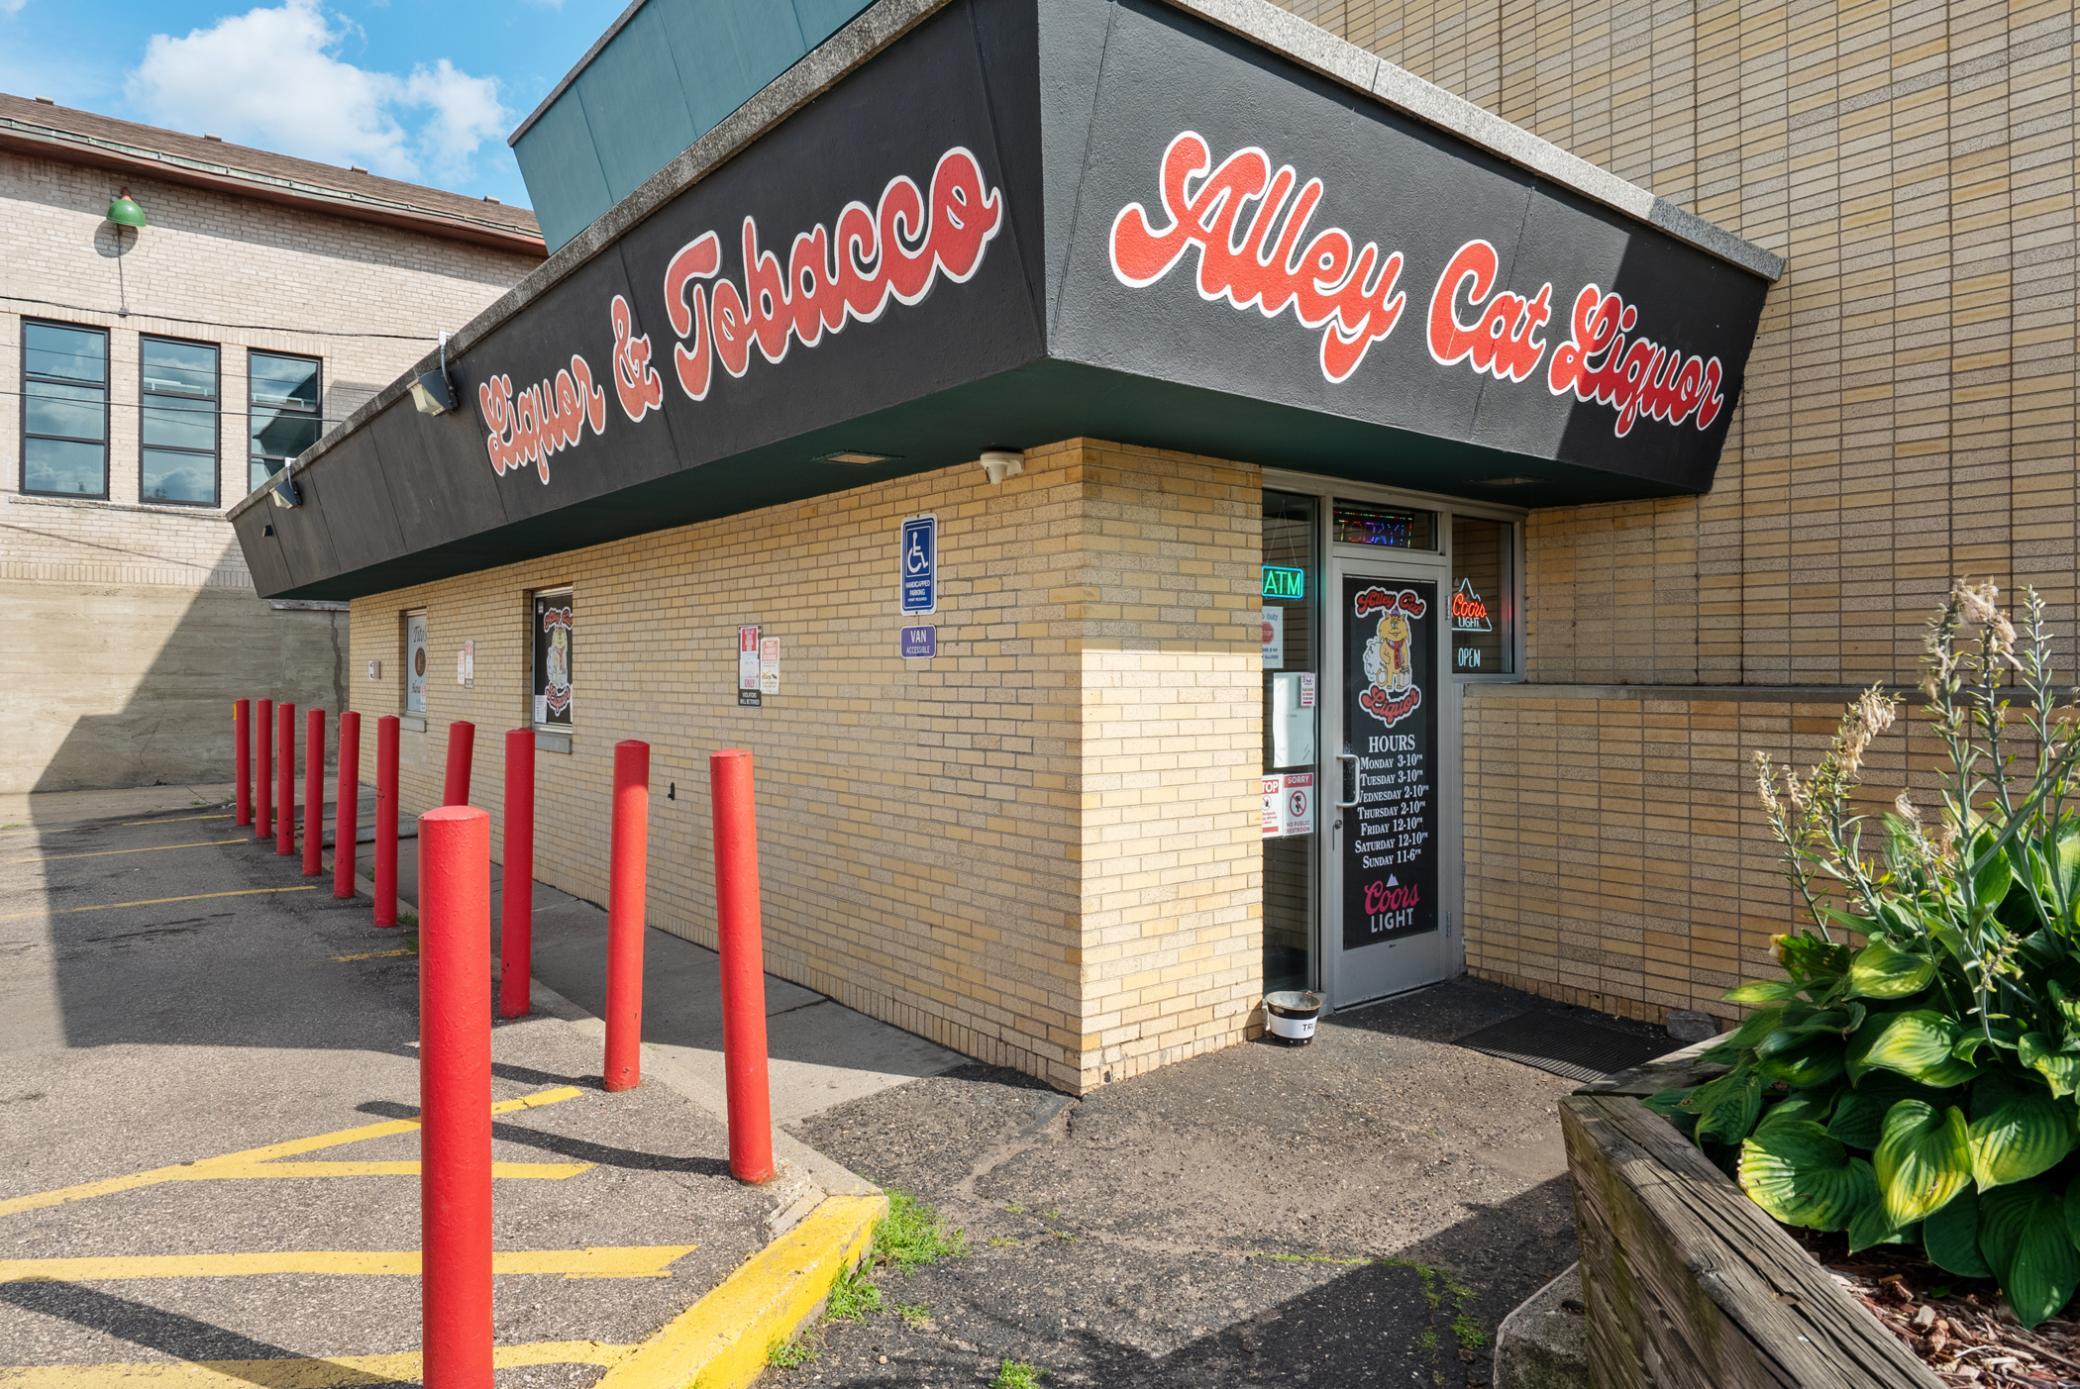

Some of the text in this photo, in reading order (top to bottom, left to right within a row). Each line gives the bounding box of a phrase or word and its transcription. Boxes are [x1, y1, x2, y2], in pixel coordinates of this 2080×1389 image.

[1108, 130, 1724, 438] Alley Cat Liquor
[479, 146, 1002, 485] Liquor & Tobacco
[1263, 570, 1300, 595] ATM
[1452, 593, 1487, 618] Coors
[1458, 617, 1480, 628] LIGHT
[910, 630, 927, 643] VAN
[906, 645, 930, 654] ACCESSIBLE
[1458, 647, 1481, 668] OPEN
[1360, 685, 1420, 726] Liquor
[1368, 734, 1416, 753] HOURS
[1360, 756, 1394, 770] MONDAY
[1263, 781, 1279, 793] TOP
[1287, 775, 1310, 785] SORRY
[1360, 773, 1396, 786] TUESDAY
[1357, 806, 1399, 820] THURSDAY
[1360, 822, 1390, 836] FRIDAY
[1355, 838, 1395, 854] SATURDAY
[1363, 855, 1394, 869] SUNDAY
[1364, 880, 1420, 916] Coors
[1371, 908, 1414, 933] LIGHT
